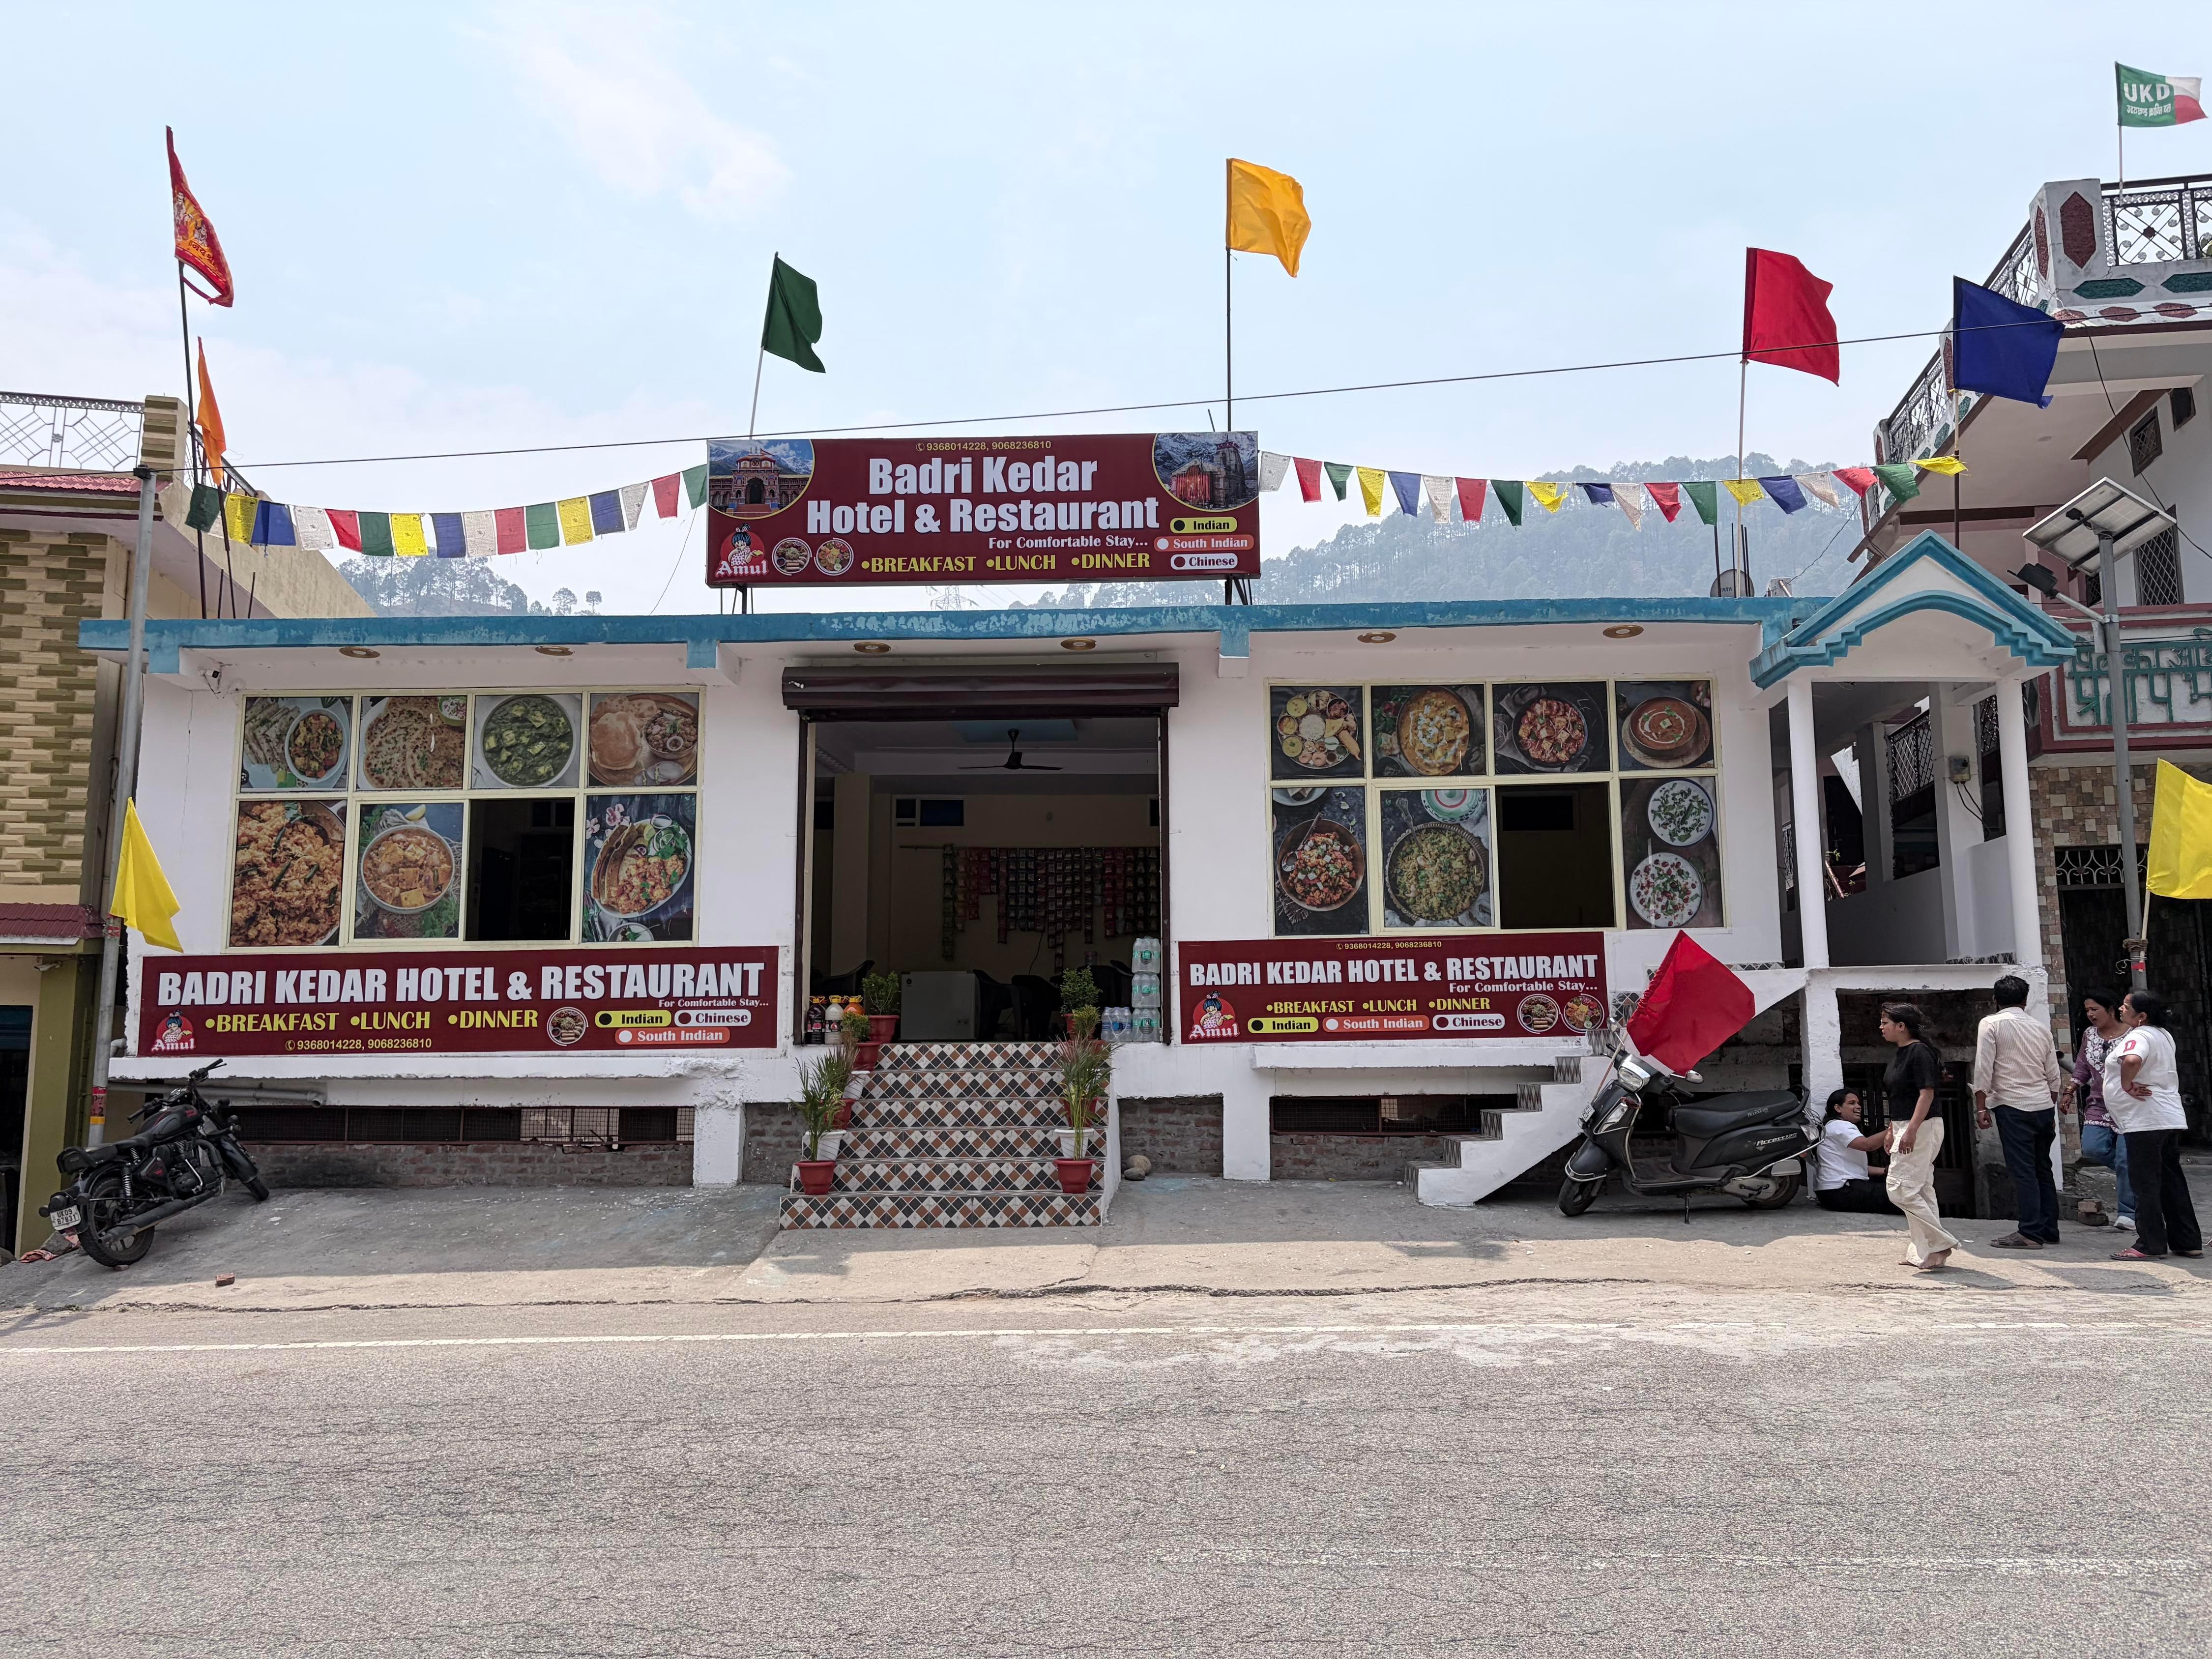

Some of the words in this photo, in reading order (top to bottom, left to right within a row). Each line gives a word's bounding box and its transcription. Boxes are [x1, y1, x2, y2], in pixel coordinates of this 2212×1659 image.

[2124, 83, 2170, 103] UKD
[927, 442, 989, 451] 9368014228,
[992, 441, 1051, 449] 9068236810
[870, 457, 971, 494] Badri
[983, 456, 1097, 493] Kedar
[808, 500, 904, 533] Hotel
[915, 504, 940, 533] &
[951, 497, 1159, 531] Restaurant
[1194, 521, 1229, 530] Indian
[990, 538, 1012, 549] For
[1017, 536, 1101, 548] Comfortable
[1106, 535, 1147, 548] Stay...
[1174, 539, 1206, 549] South
[1212, 538, 1247, 548] Indian
[1189, 557, 1234, 566] Chinese
[716, 559, 768, 576] Amul
[1190, 962, 1260, 986] BADRI
[1267, 961, 1341, 984] KEDAR
[1348, 959, 1419, 982] HOTEL
[1424, 962, 1441, 981] &
[1447, 955, 1598, 980] RESTAURANT
[158, 971, 266, 1005] BADRI
[275, 969, 386, 1003] KEDAR
[396, 967, 498, 1001] HOTEL
[507, 972, 531, 1000] &
[541, 963, 764, 999] RESTAURANT
[1450, 983, 1470, 992] For
[1475, 981, 1553, 992] Comfortable
[1558, 981, 1597, 992] Stay...
[740, 998, 768, 1007] Stay...
[622, 1014, 662, 1024] Indian
[696, 1013, 748, 1023] Chinese
[1343, 1019, 1379, 1029] South
[1384, 1018, 1423, 1028] Indian
[1453, 1018, 1501, 1026] Chinese
[1190, 1023, 1239, 1038] Amul
[1273, 1020, 1310, 1030] Indian
[638, 1031, 675, 1041] South
[681, 1030, 722, 1040] Indian
[151, 1038, 195, 1051] Amul
[297, 1040, 364, 1050] 9368014228,
[368, 1039, 431, 1048] 9068236810
[57, 1209, 73, 1218] UK09
